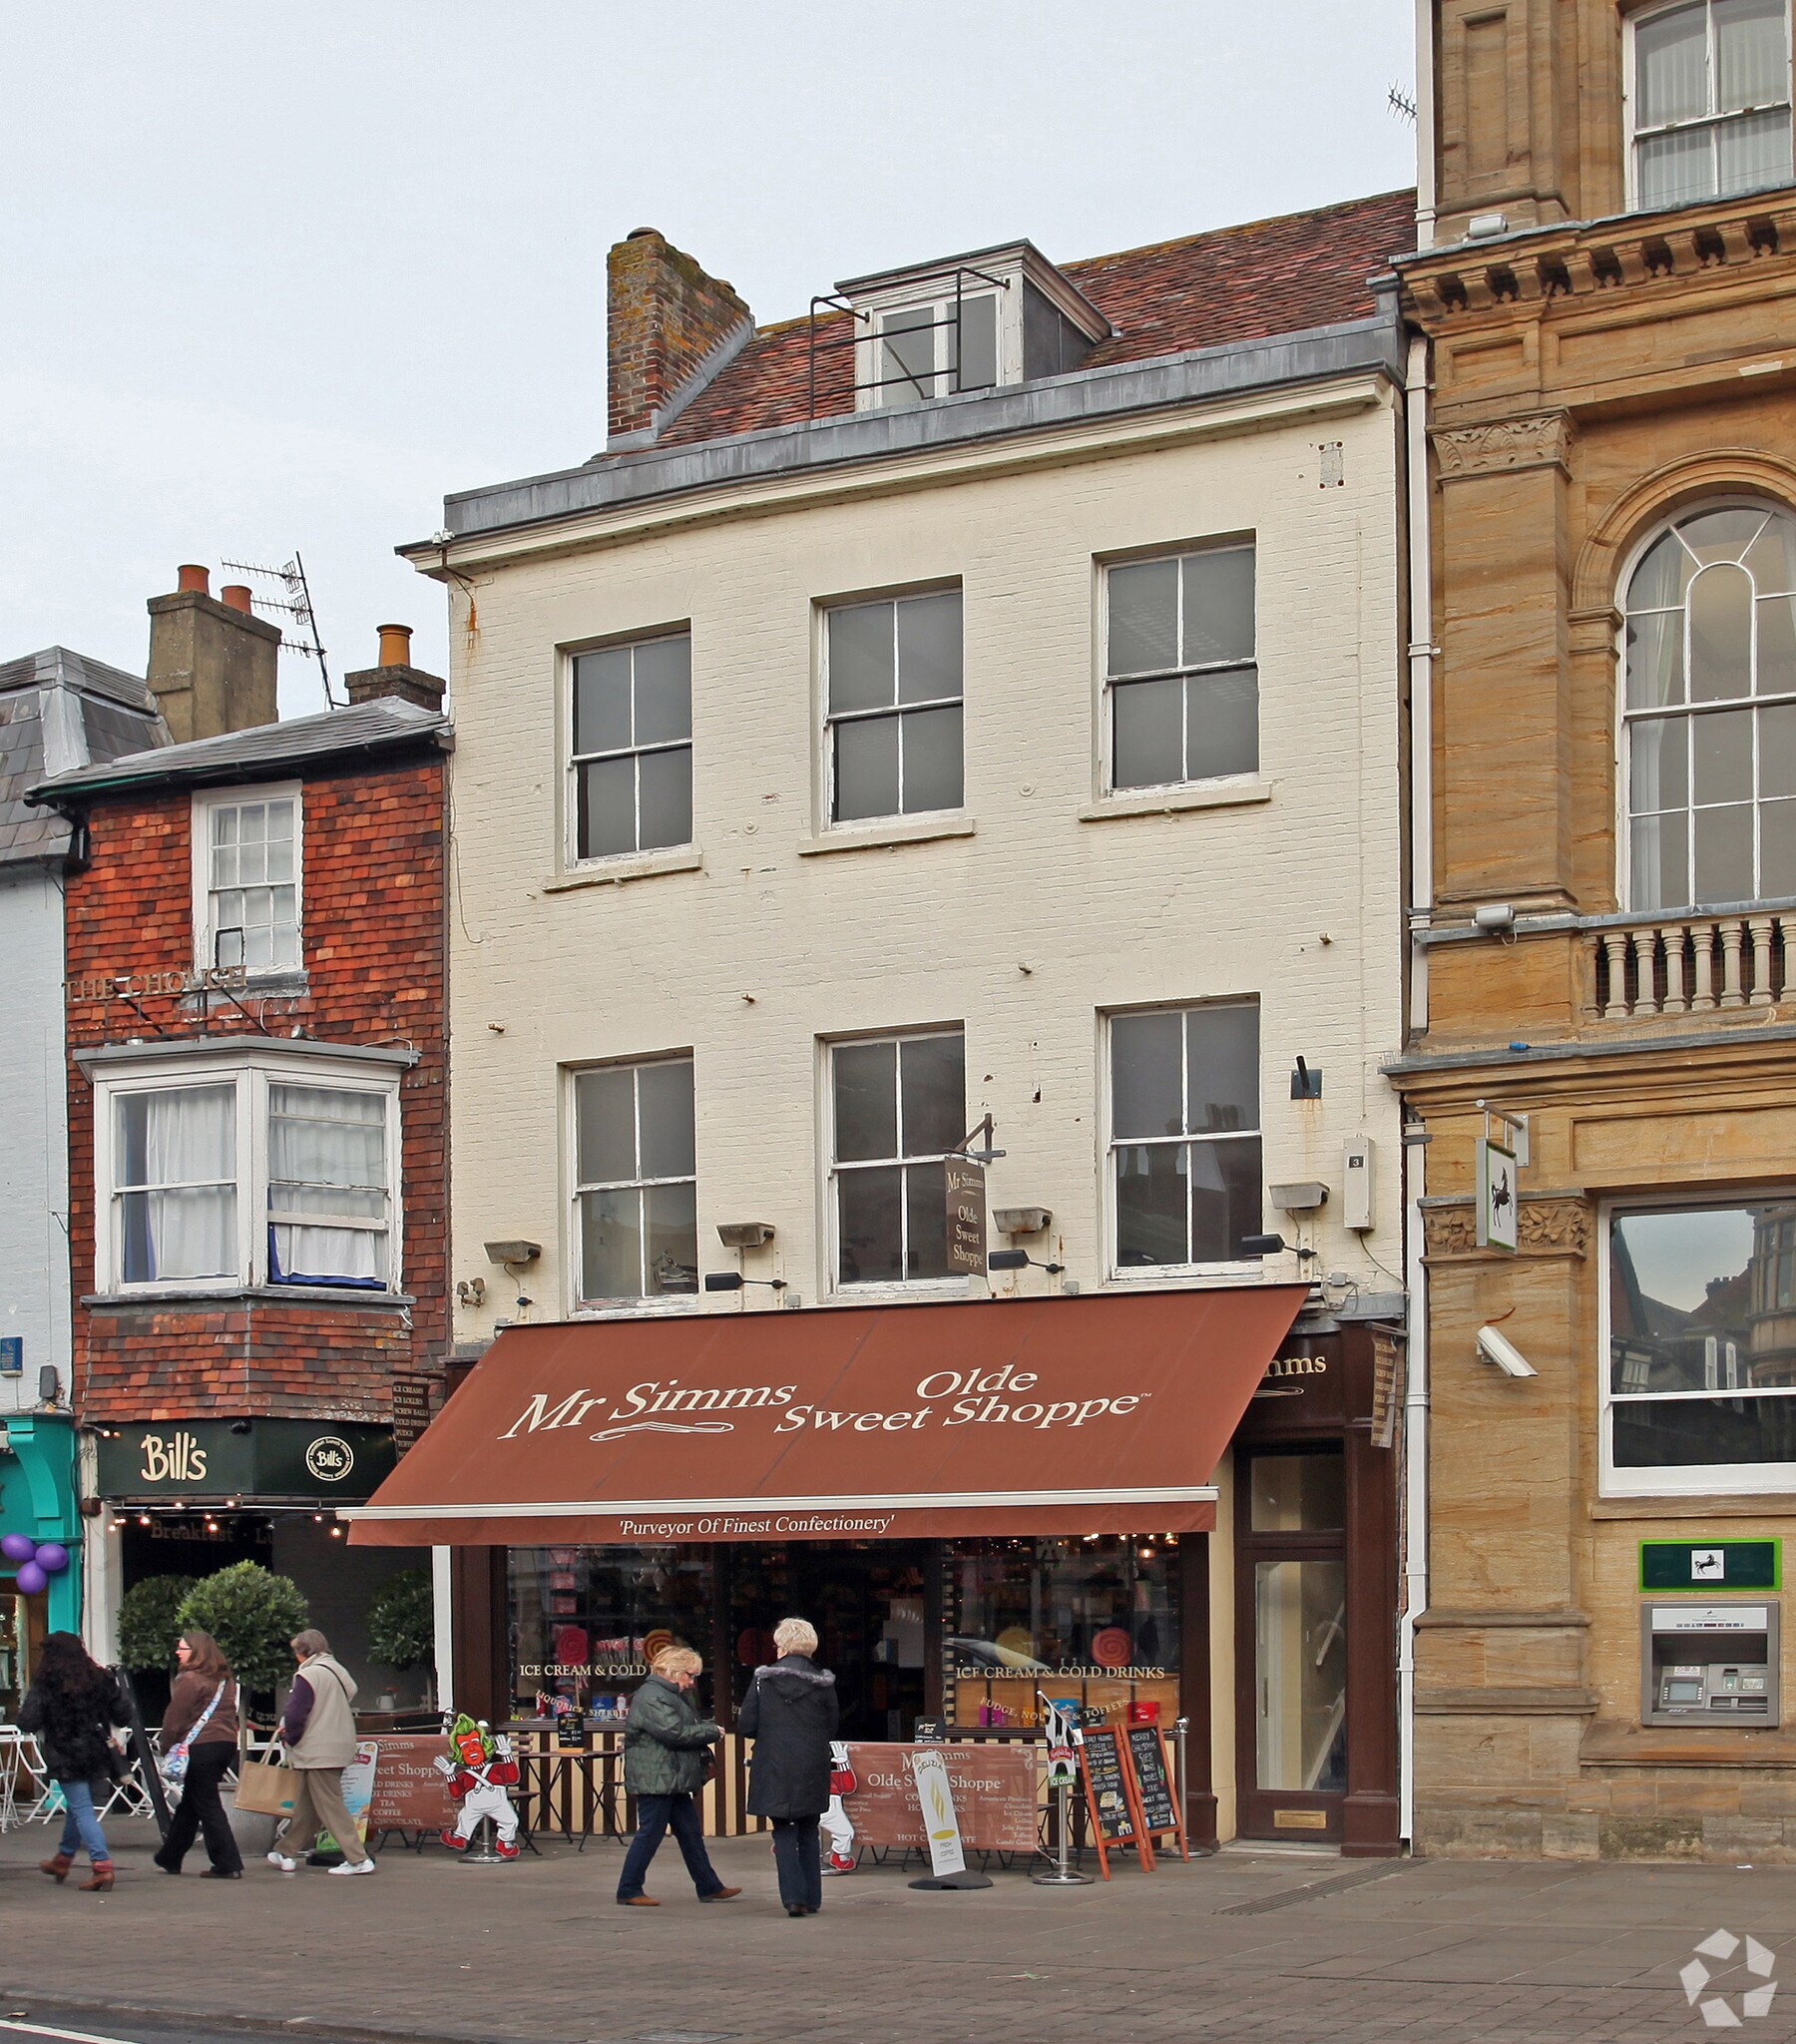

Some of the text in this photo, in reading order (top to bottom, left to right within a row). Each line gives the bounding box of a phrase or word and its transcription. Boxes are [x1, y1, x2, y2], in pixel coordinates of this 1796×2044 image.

[62, 964, 247, 1001] THE CHOUGH
[947, 1172, 984, 1193] Mr Simms
[958, 1205, 978, 1224] Olde
[956, 1225, 980, 1245] Sweet
[953, 1244, 983, 1268] Shoppe
[1264, 1356, 1327, 1377] mms
[916, 1364, 1039, 1398] Olde
[497, 1379, 798, 1439] Mr Simms
[773, 1404, 933, 1433] Sweet
[141, 1431, 208, 1481] Bill's
[316, 1450, 343, 1467] Bill's
[151, 1520, 234, 1542] Breakfast
[698, 1518, 721, 1534] Of
[722, 1517, 771, 1533] Finest
[775, 1514, 895, 1534] Confectionery'
[520, 1665, 647, 1677] ICE CREAM & COLD
[984, 1666, 1038, 1679] CREAM
[1042, 1667, 1055, 1679] &
[1059, 1666, 1101, 1679] COLD
[1106, 1666, 1165, 1679] DRINKS
[1072, 1712, 1081, 1721] &
[1083, 1698, 1130, 1720] TOFFEES
[377, 1740, 415, 1752] Simms
[378, 1765, 394, 1775] eet
[901, 1752, 916, 1773] M
[868, 1774, 901, 1788] Olde
[950, 1774, 1002, 1791] Shoppe
